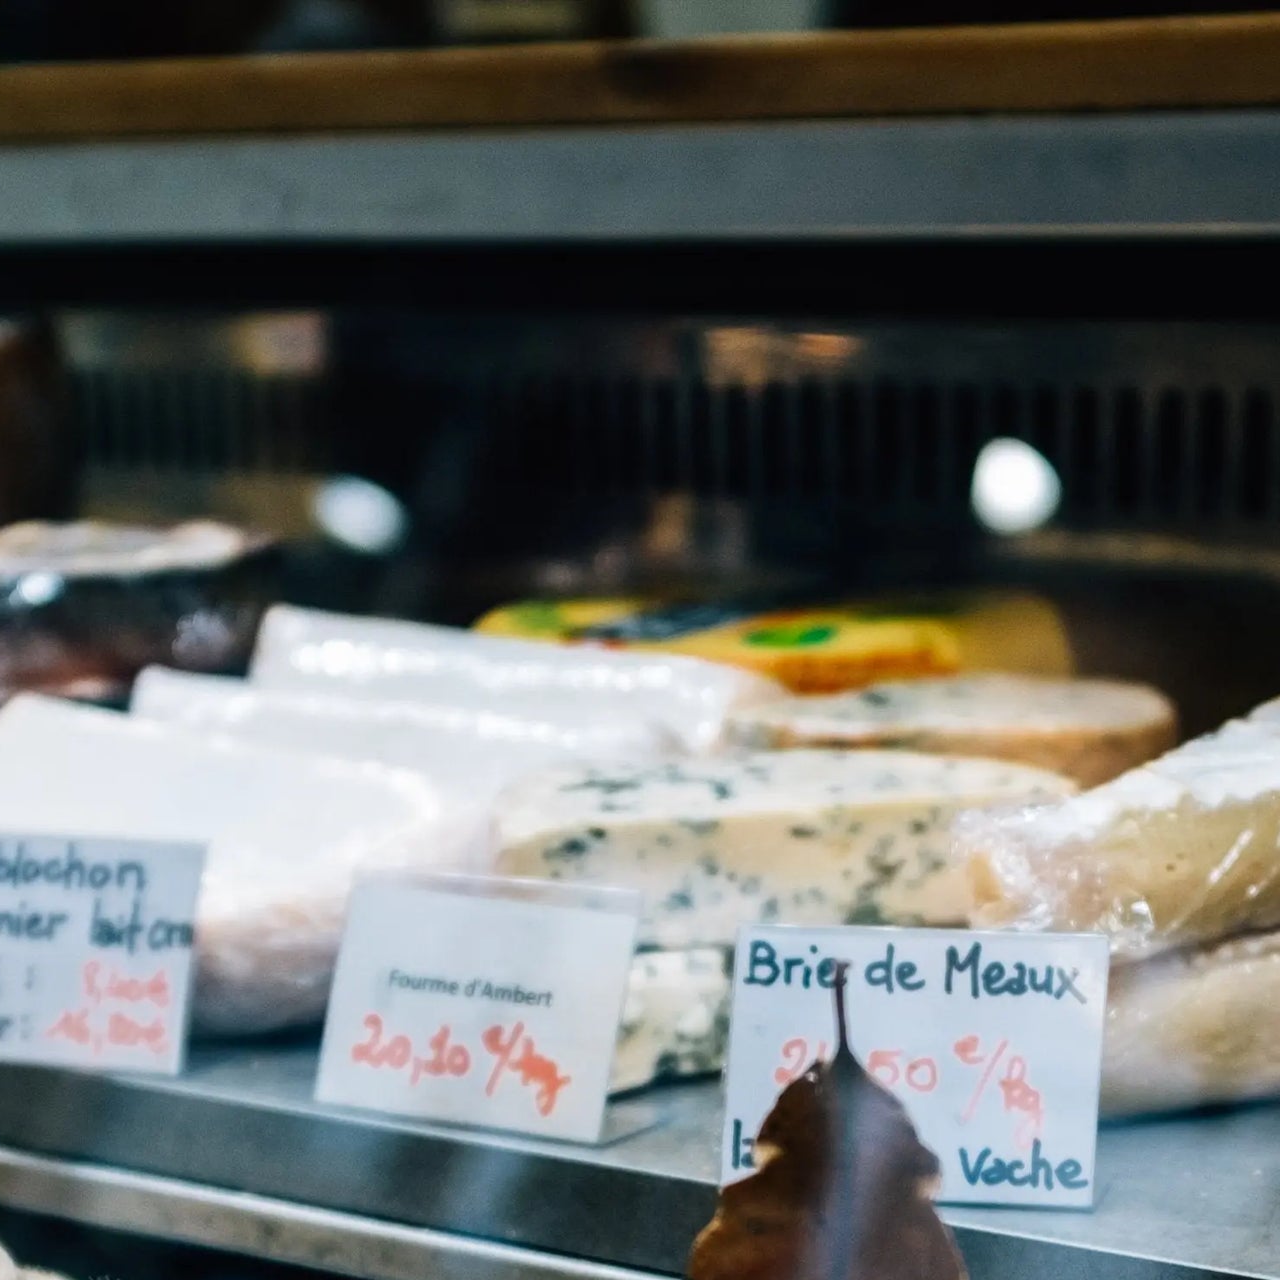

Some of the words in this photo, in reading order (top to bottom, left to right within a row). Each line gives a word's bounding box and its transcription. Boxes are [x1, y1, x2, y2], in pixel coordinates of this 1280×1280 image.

[388, 968, 459, 997] Fourme
[463, 978, 555, 1009] d'Ambert
[743, 940, 838, 989] Brie
[864, 943, 926, 994] de
[944, 941, 1088, 1004] Meaux
[959, 1138, 1089, 1191] Vache
